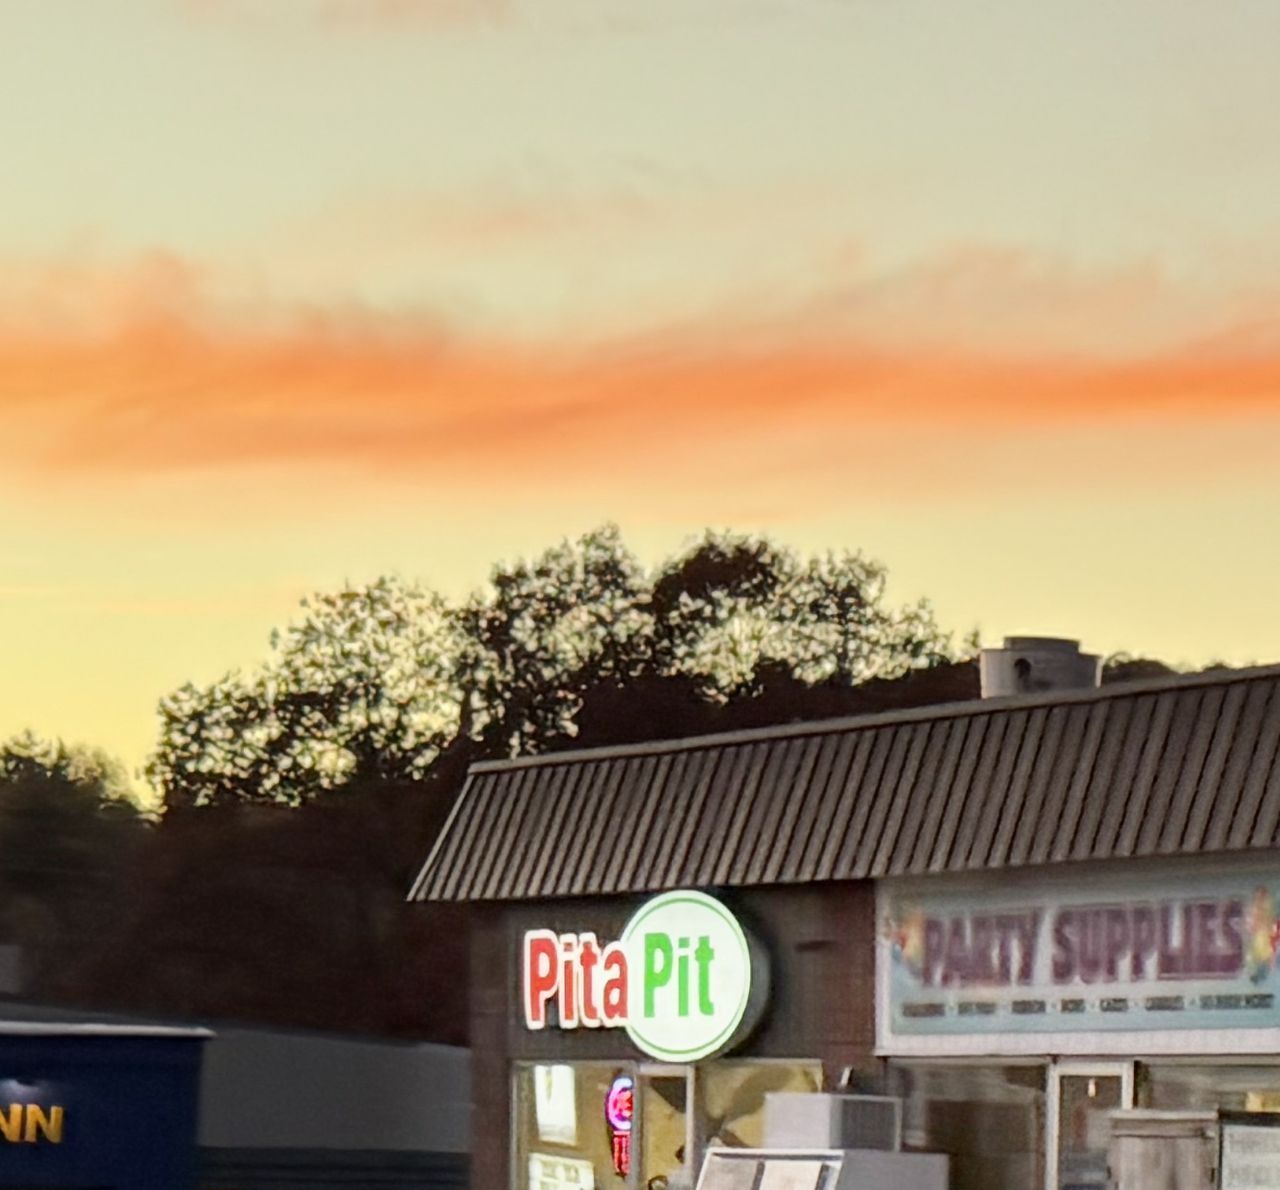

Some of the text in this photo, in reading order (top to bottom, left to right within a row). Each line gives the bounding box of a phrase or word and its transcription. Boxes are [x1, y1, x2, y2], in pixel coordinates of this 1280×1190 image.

[529, 932, 716, 1022] Pita Pit
[922, 900, 1246, 987] PARTY SUPPLIES
